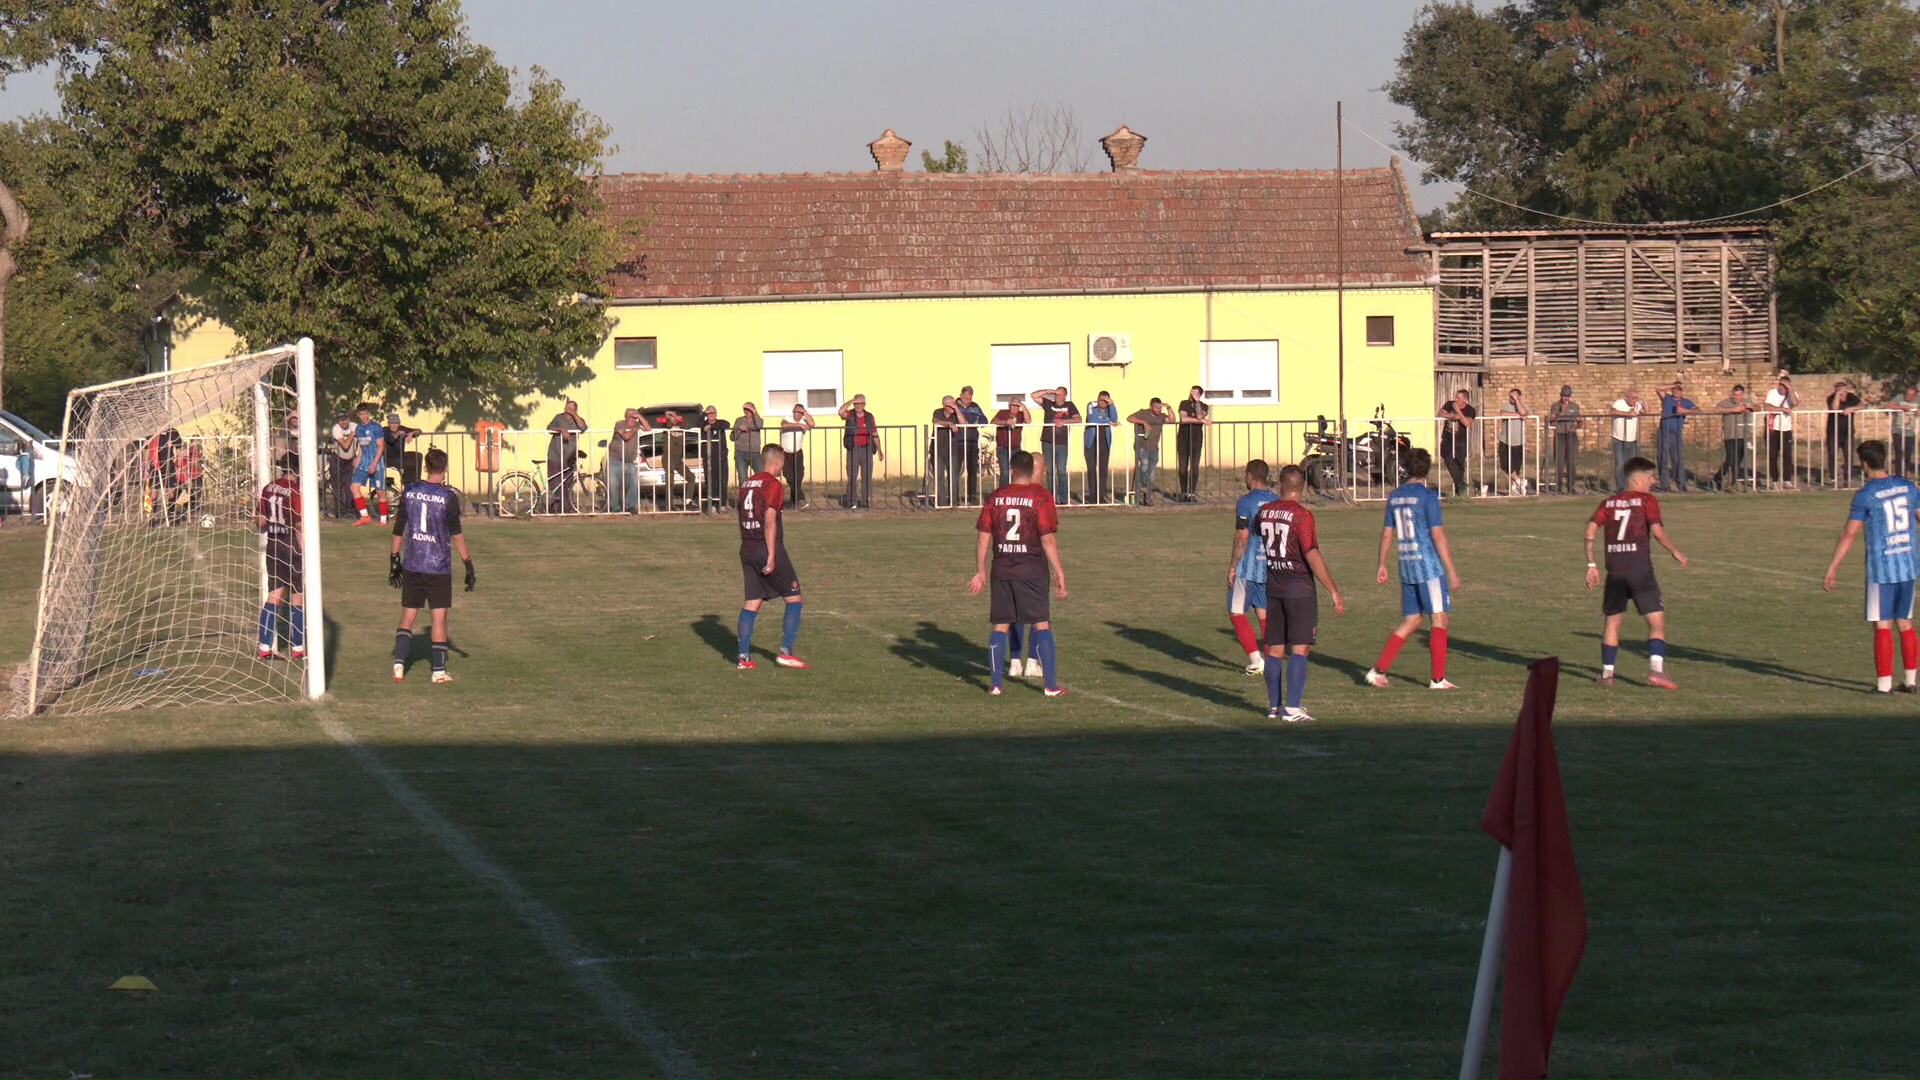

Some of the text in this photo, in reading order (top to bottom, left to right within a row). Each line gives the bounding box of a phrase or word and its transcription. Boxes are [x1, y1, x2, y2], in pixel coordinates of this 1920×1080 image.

[406, 491, 446, 505] FK DOLINA
[744, 489, 754, 519] 4
[995, 496, 1033, 508] FK DOLINA
[420, 502, 427, 533] 1
[1005, 508, 1021, 541] 2
[1394, 507, 1415, 540] 16
[1614, 509, 1631, 541] 7
[1883, 496, 1910, 533] 15
[1260, 521, 1289, 558] 27
